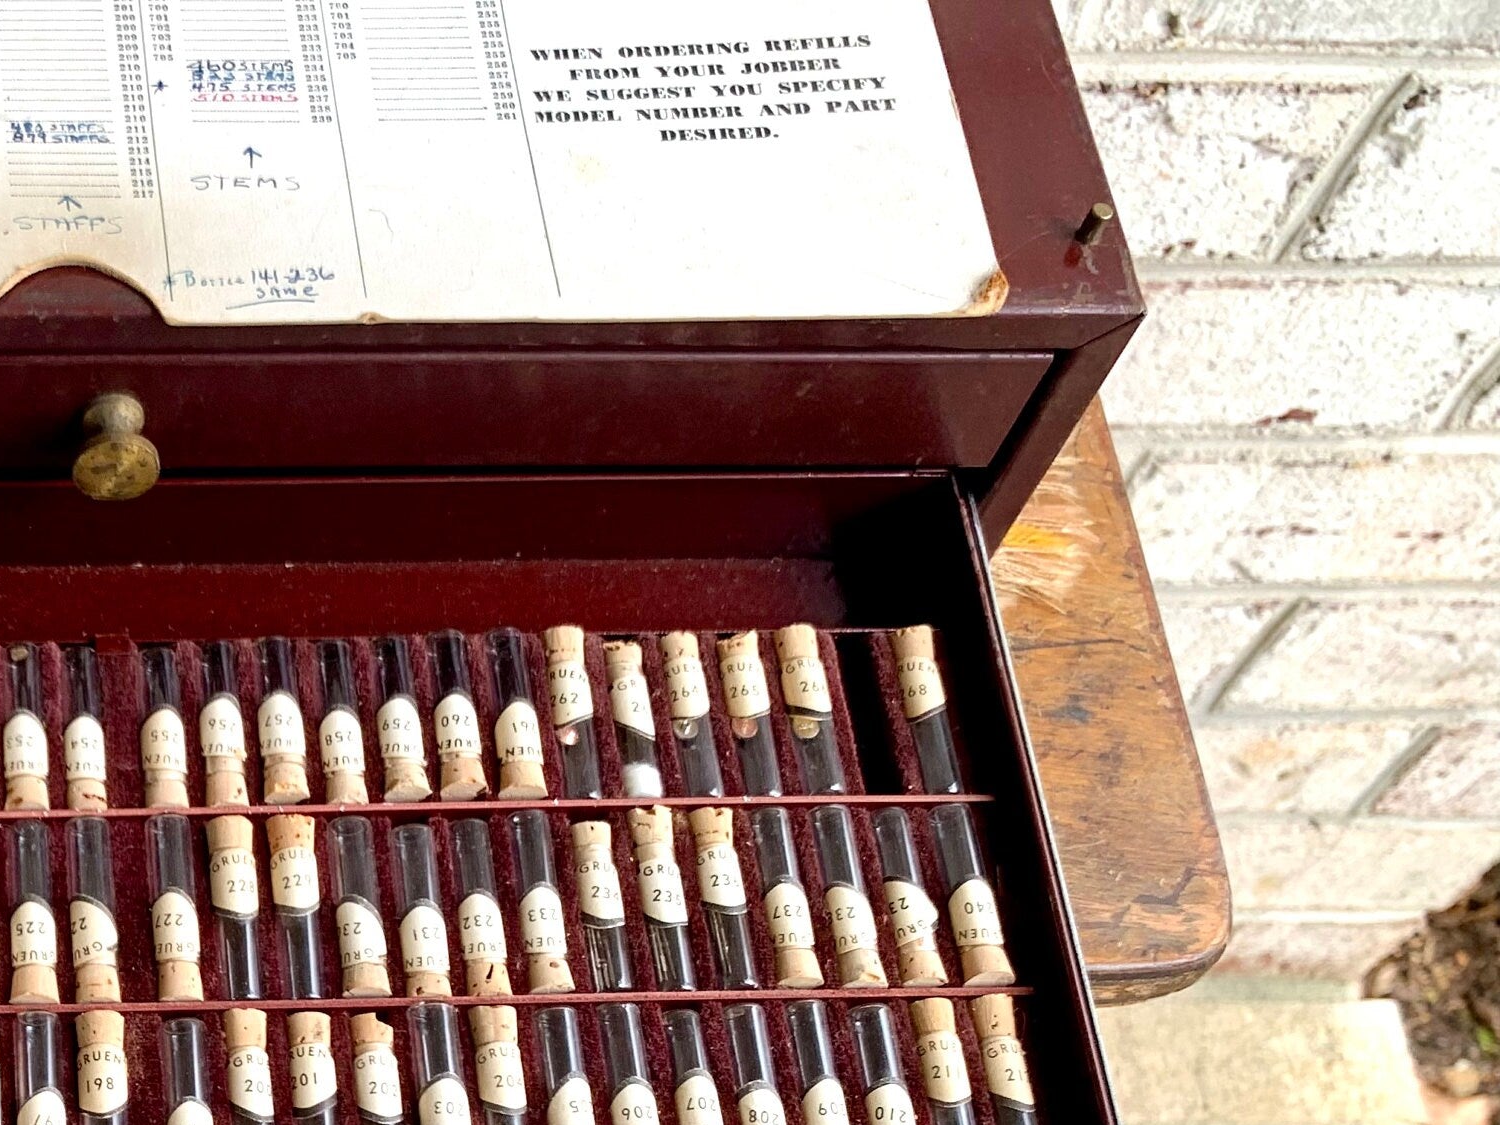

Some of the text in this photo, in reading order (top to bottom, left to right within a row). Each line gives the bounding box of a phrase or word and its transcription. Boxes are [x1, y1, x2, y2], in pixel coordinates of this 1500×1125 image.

[530, 34, 872, 62] WHEN ORDERING REFILLS
[569, 58, 842, 81] FROM YOUR JOBBER
[533, 77, 886, 103] WE SUGGEST YOU SPECIFY
[494, 102, 516, 110] 260
[534, 98, 896, 124] MODEL NUMBER AND PART
[496, 112, 517, 120] 261
[127, 136, 148, 144] 212
[659, 126, 779, 142] DESIRED.
[132, 179, 153, 187] 216
[190, 175, 300, 191] STEMS
[133, 190, 154, 198] 217
[13, 215, 123, 234] STAFFS
[155, 913, 184, 928] 227
[463, 914, 493, 929] 232
[527, 908, 558, 923] 233
[16, 920, 46, 934] 225
[86, 1077, 115, 1093] 198
[291, 1073, 317, 1089] 201
[686, 1098, 716, 1112] 207
[621, 1106, 653, 1120] 206
[748, 1109, 779, 1124] 208
[874, 1106, 906, 1122] 210
